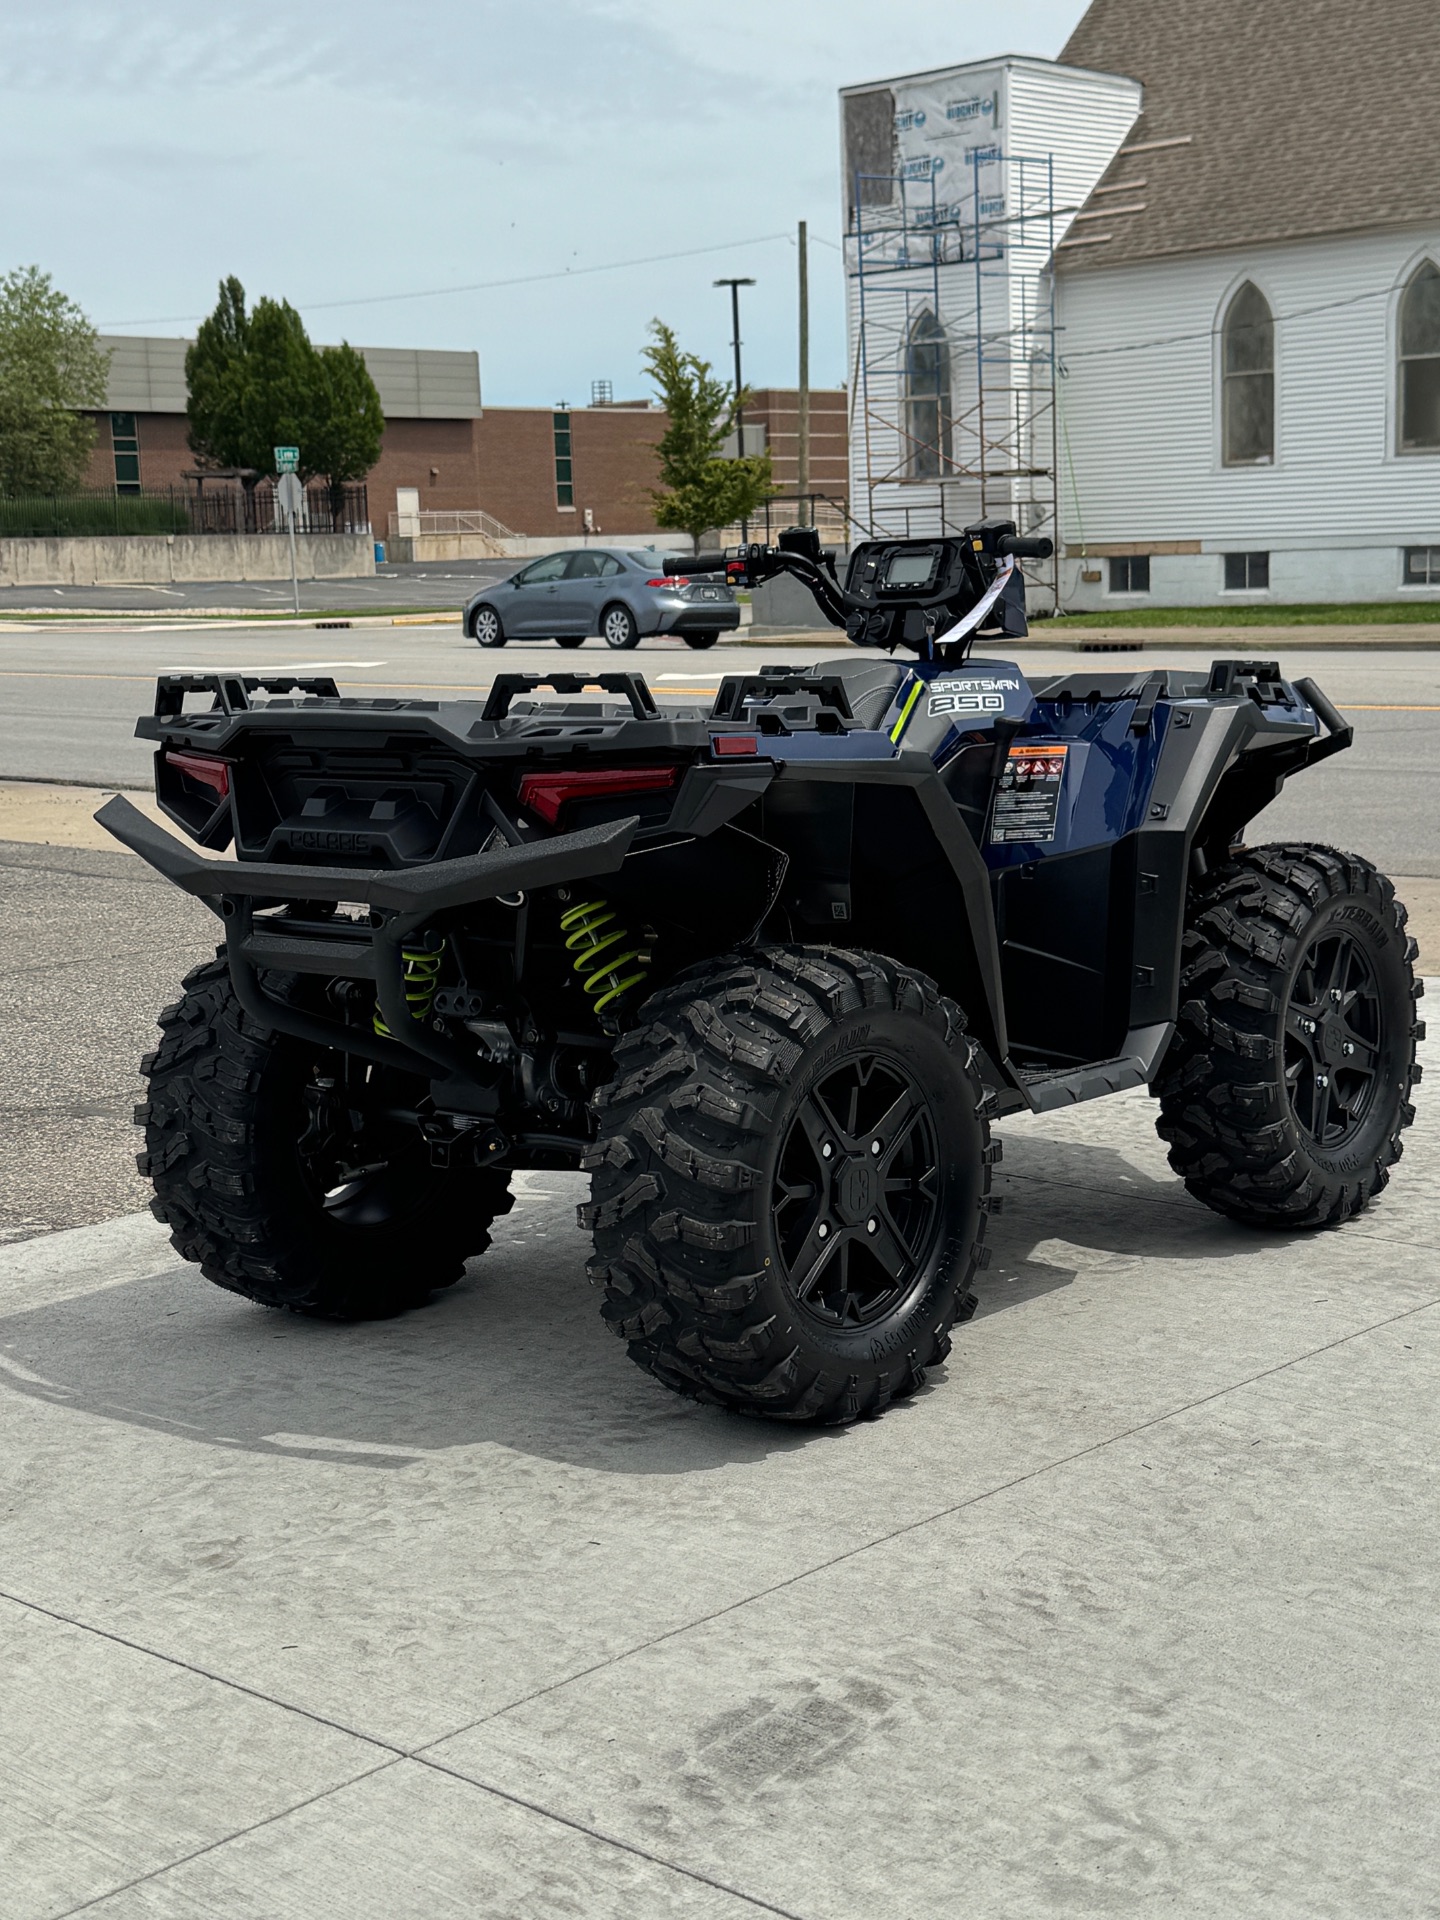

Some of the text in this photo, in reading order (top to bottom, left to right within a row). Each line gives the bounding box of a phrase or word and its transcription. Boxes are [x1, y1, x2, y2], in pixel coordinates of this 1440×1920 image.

[929, 679, 1020, 693] SPORTSMAN
[928, 694, 1004, 717] 850
[290, 830, 369, 852] POLARIS
